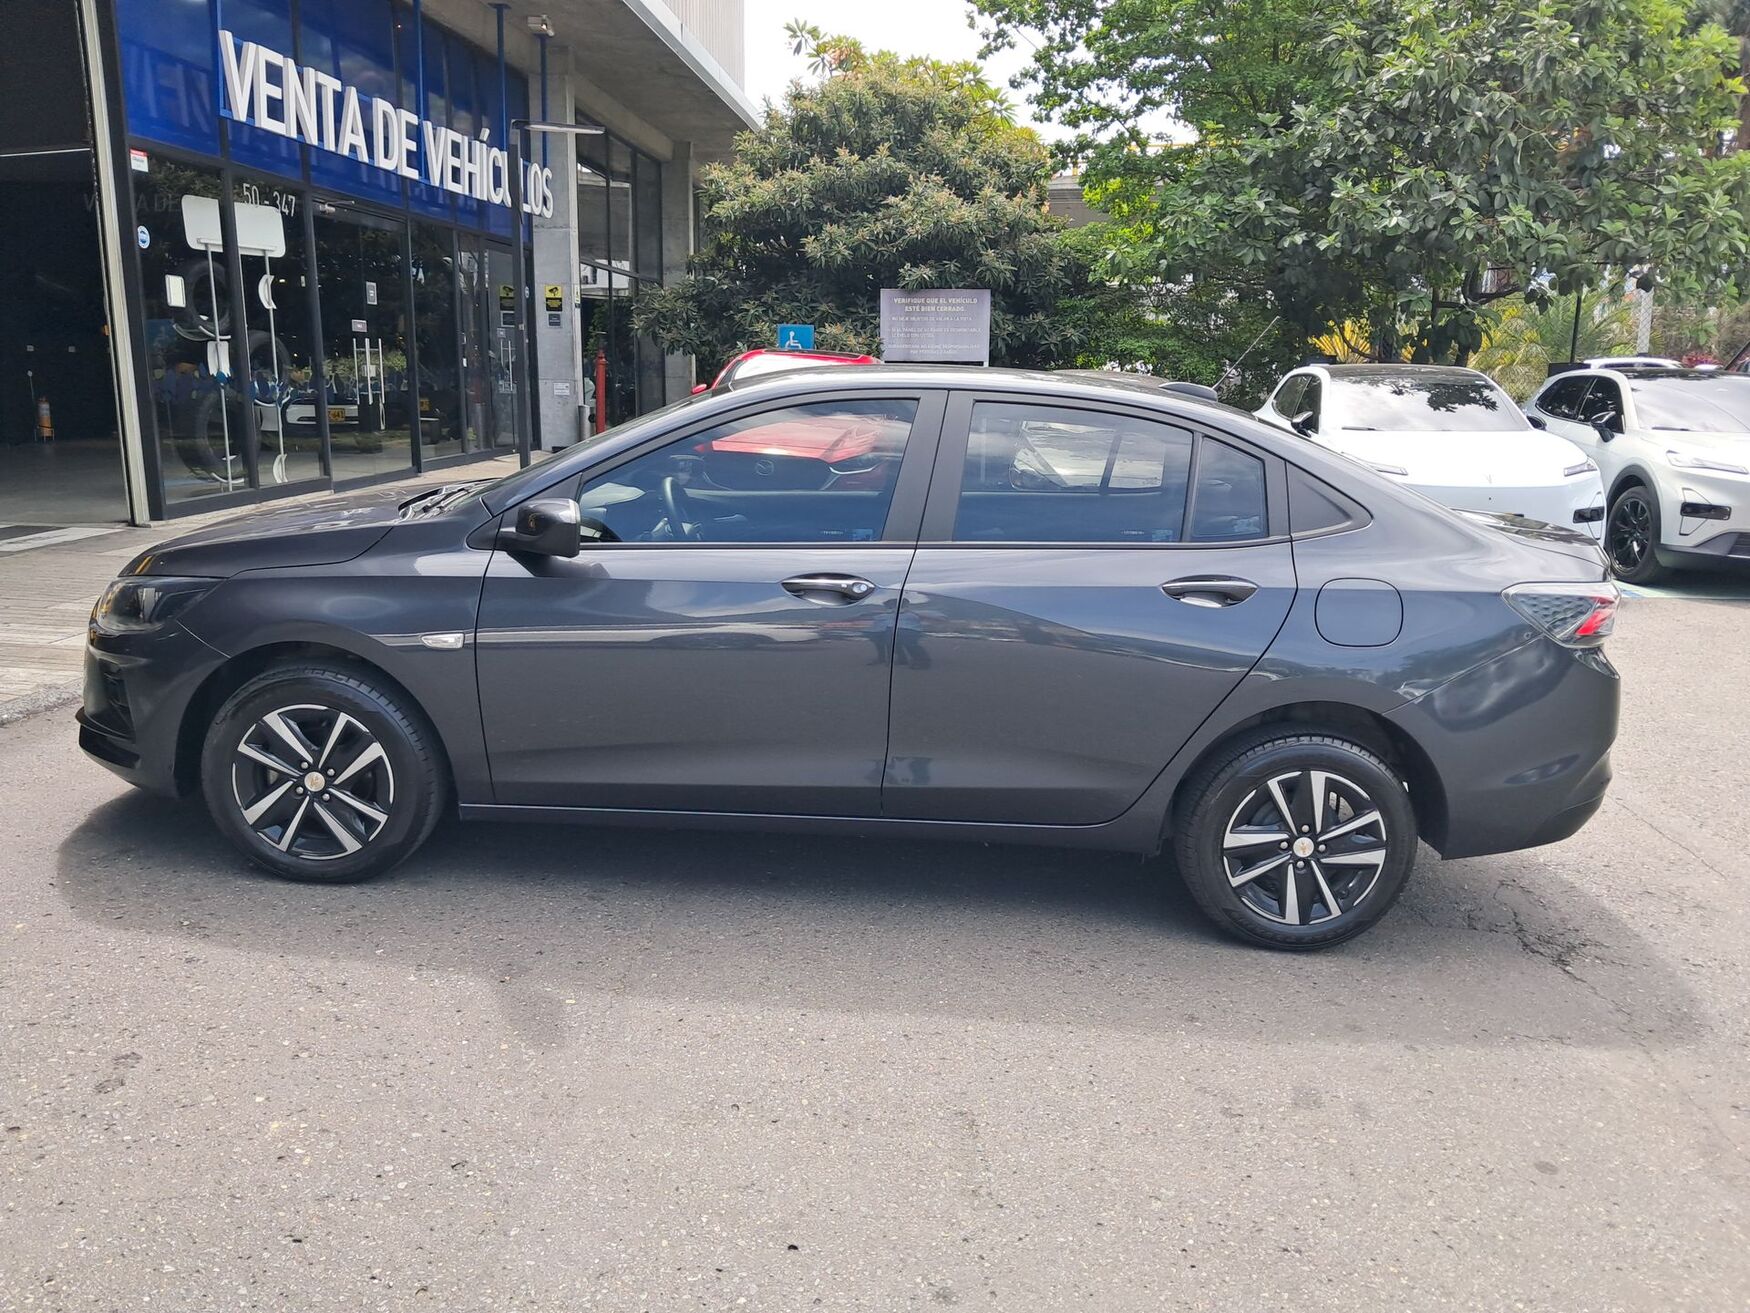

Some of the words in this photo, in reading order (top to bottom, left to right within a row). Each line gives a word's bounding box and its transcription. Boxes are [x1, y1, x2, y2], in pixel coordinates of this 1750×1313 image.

[218, 29, 369, 164] VENTA
[372, 97, 420, 180] DE
[243, 183, 259, 207] 50
[273, 191, 296, 217] 347
[904, 304, 920, 312] ESTÉ
[948, 296, 978, 304] VEHÍCULO
